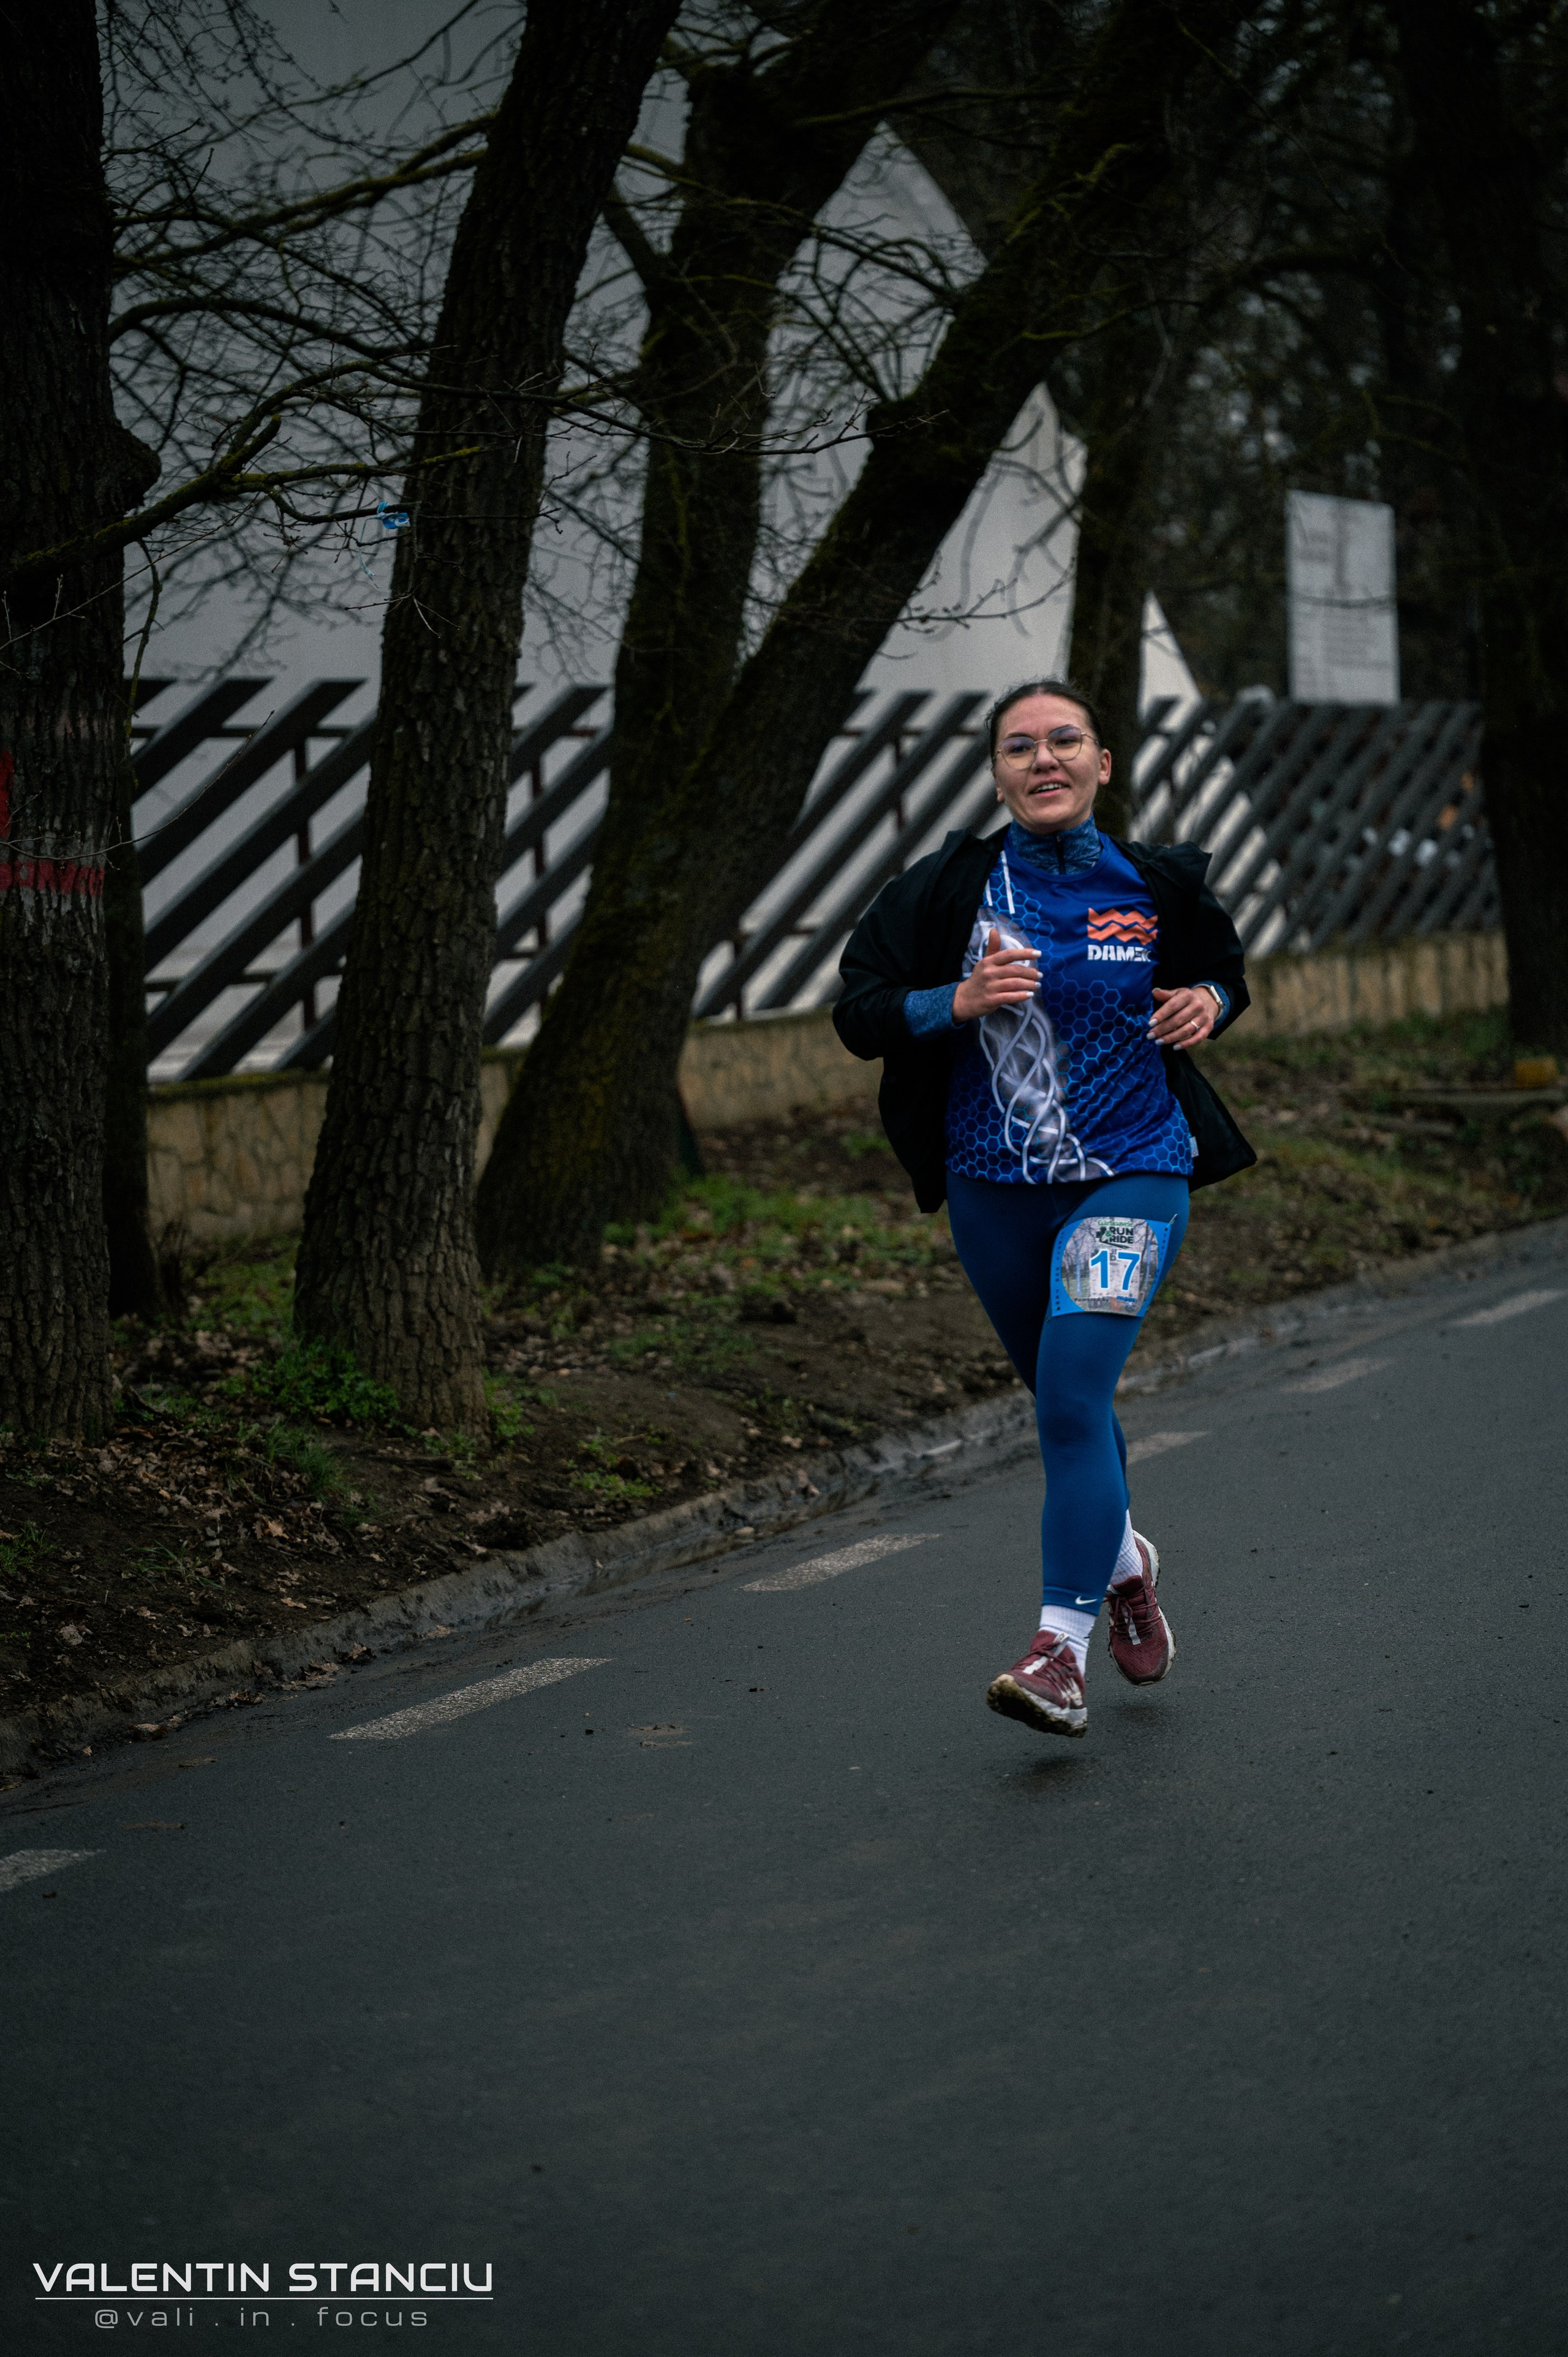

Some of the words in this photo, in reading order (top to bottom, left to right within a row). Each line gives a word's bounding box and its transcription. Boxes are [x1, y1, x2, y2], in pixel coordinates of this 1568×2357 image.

[1109, 1226, 1134, 1235] RUN
[1109, 1235, 1134, 1244] RIDE
[1090, 1250, 1140, 1291] 17
